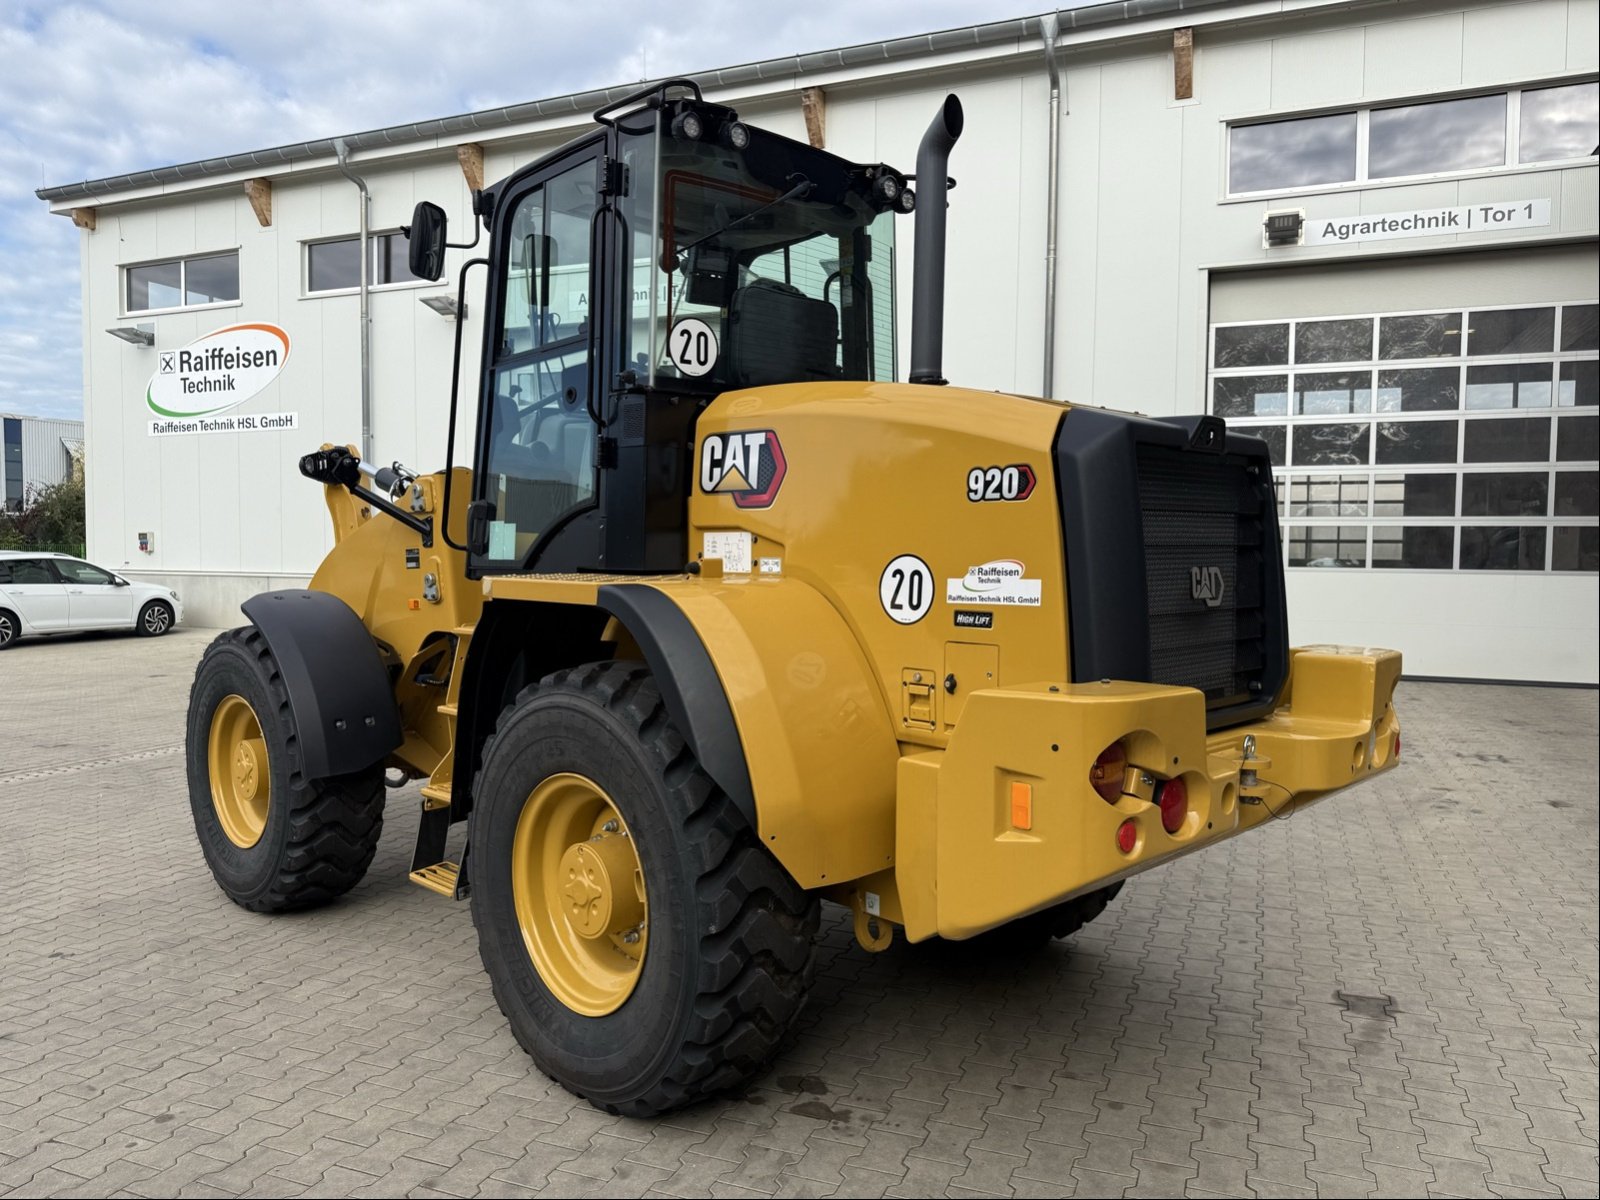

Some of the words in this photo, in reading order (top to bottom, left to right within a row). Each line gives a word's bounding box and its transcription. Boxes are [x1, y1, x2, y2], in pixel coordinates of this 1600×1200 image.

[1322, 211, 1459, 240] Agrartechnik
[1480, 207, 1516, 224] Tor
[1523, 203, 1533, 219] 1
[179, 346, 277, 373] Raiffeisen
[679, 328, 709, 367] 20
[180, 374, 236, 394] Technik
[153, 421, 198, 434] Raiffeisen
[199, 418, 235, 431] Technik
[238, 417, 258, 429] HSL
[260, 415, 293, 428] GmbH
[701, 432, 766, 492] CAT
[968, 466, 1019, 501] 920
[977, 567, 1019, 577] Raiffeisen
[1190, 566, 1217, 600] CAT
[890, 568, 923, 611] 20
[948, 594, 977, 602] Raiffeisen
[978, 595, 1001, 603] Technik
[1018, 596, 1040, 604] GmbH
